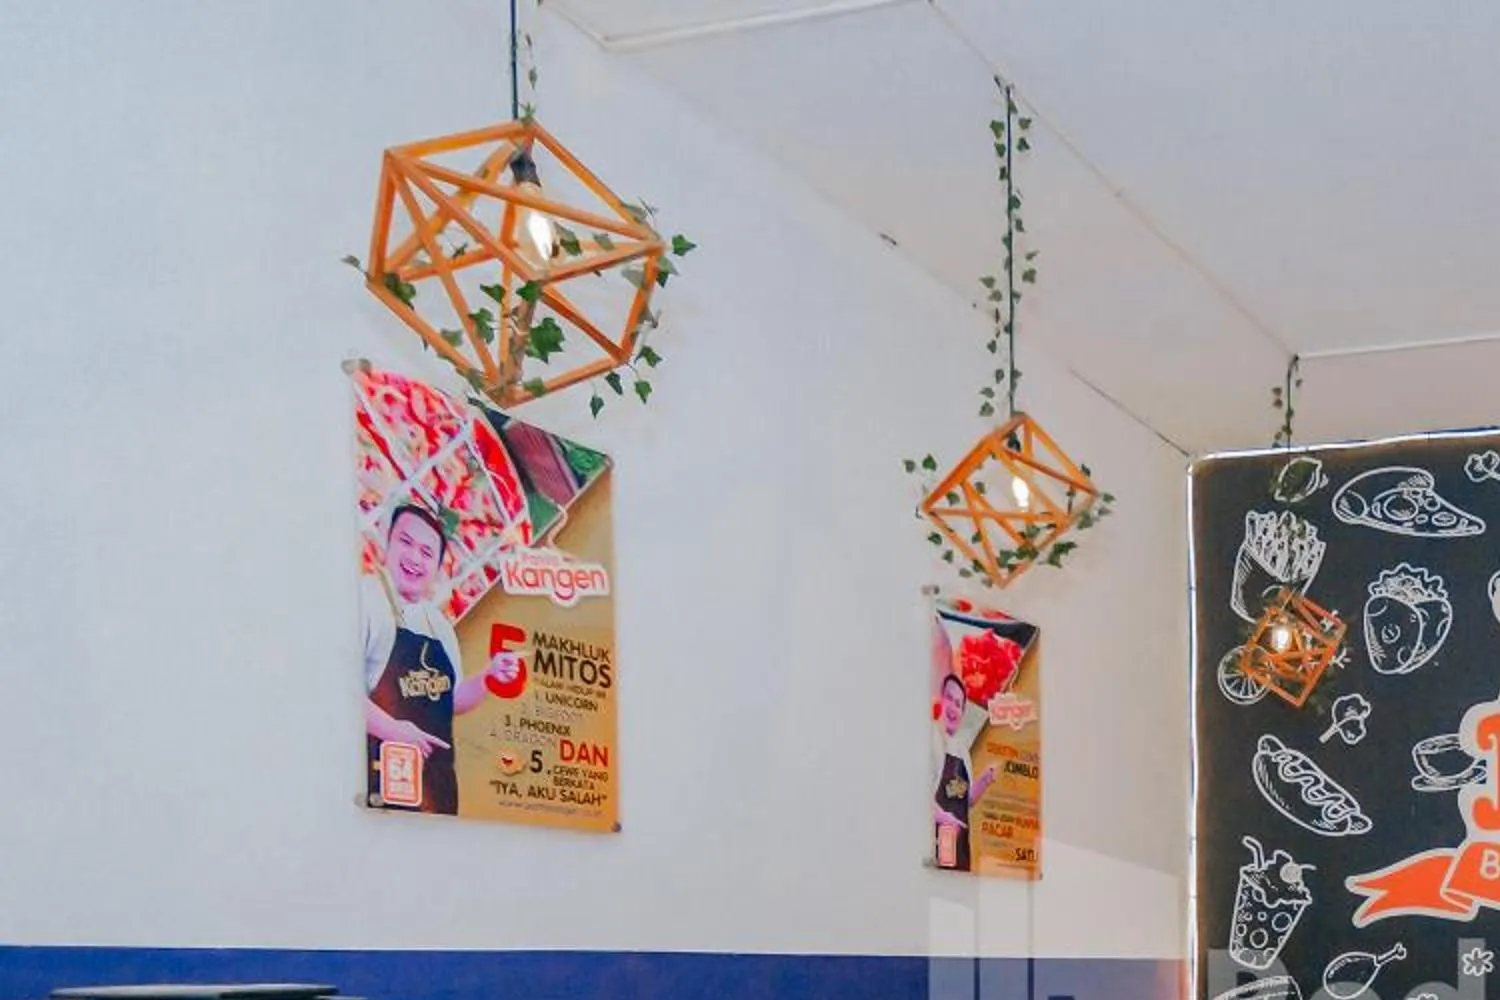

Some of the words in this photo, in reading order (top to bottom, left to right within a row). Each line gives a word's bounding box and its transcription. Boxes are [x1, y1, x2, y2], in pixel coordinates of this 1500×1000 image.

[505, 560, 606, 600] Kangen
[485, 623, 527, 699] 5
[533, 632, 611, 664] MAKHLUK
[534, 649, 611, 688] MITOS
[545, 692, 598, 713] UNICORN
[519, 717, 572, 737] PHOENIX
[559, 738, 609, 768] DAN
[527, 784, 556, 801] AKU
